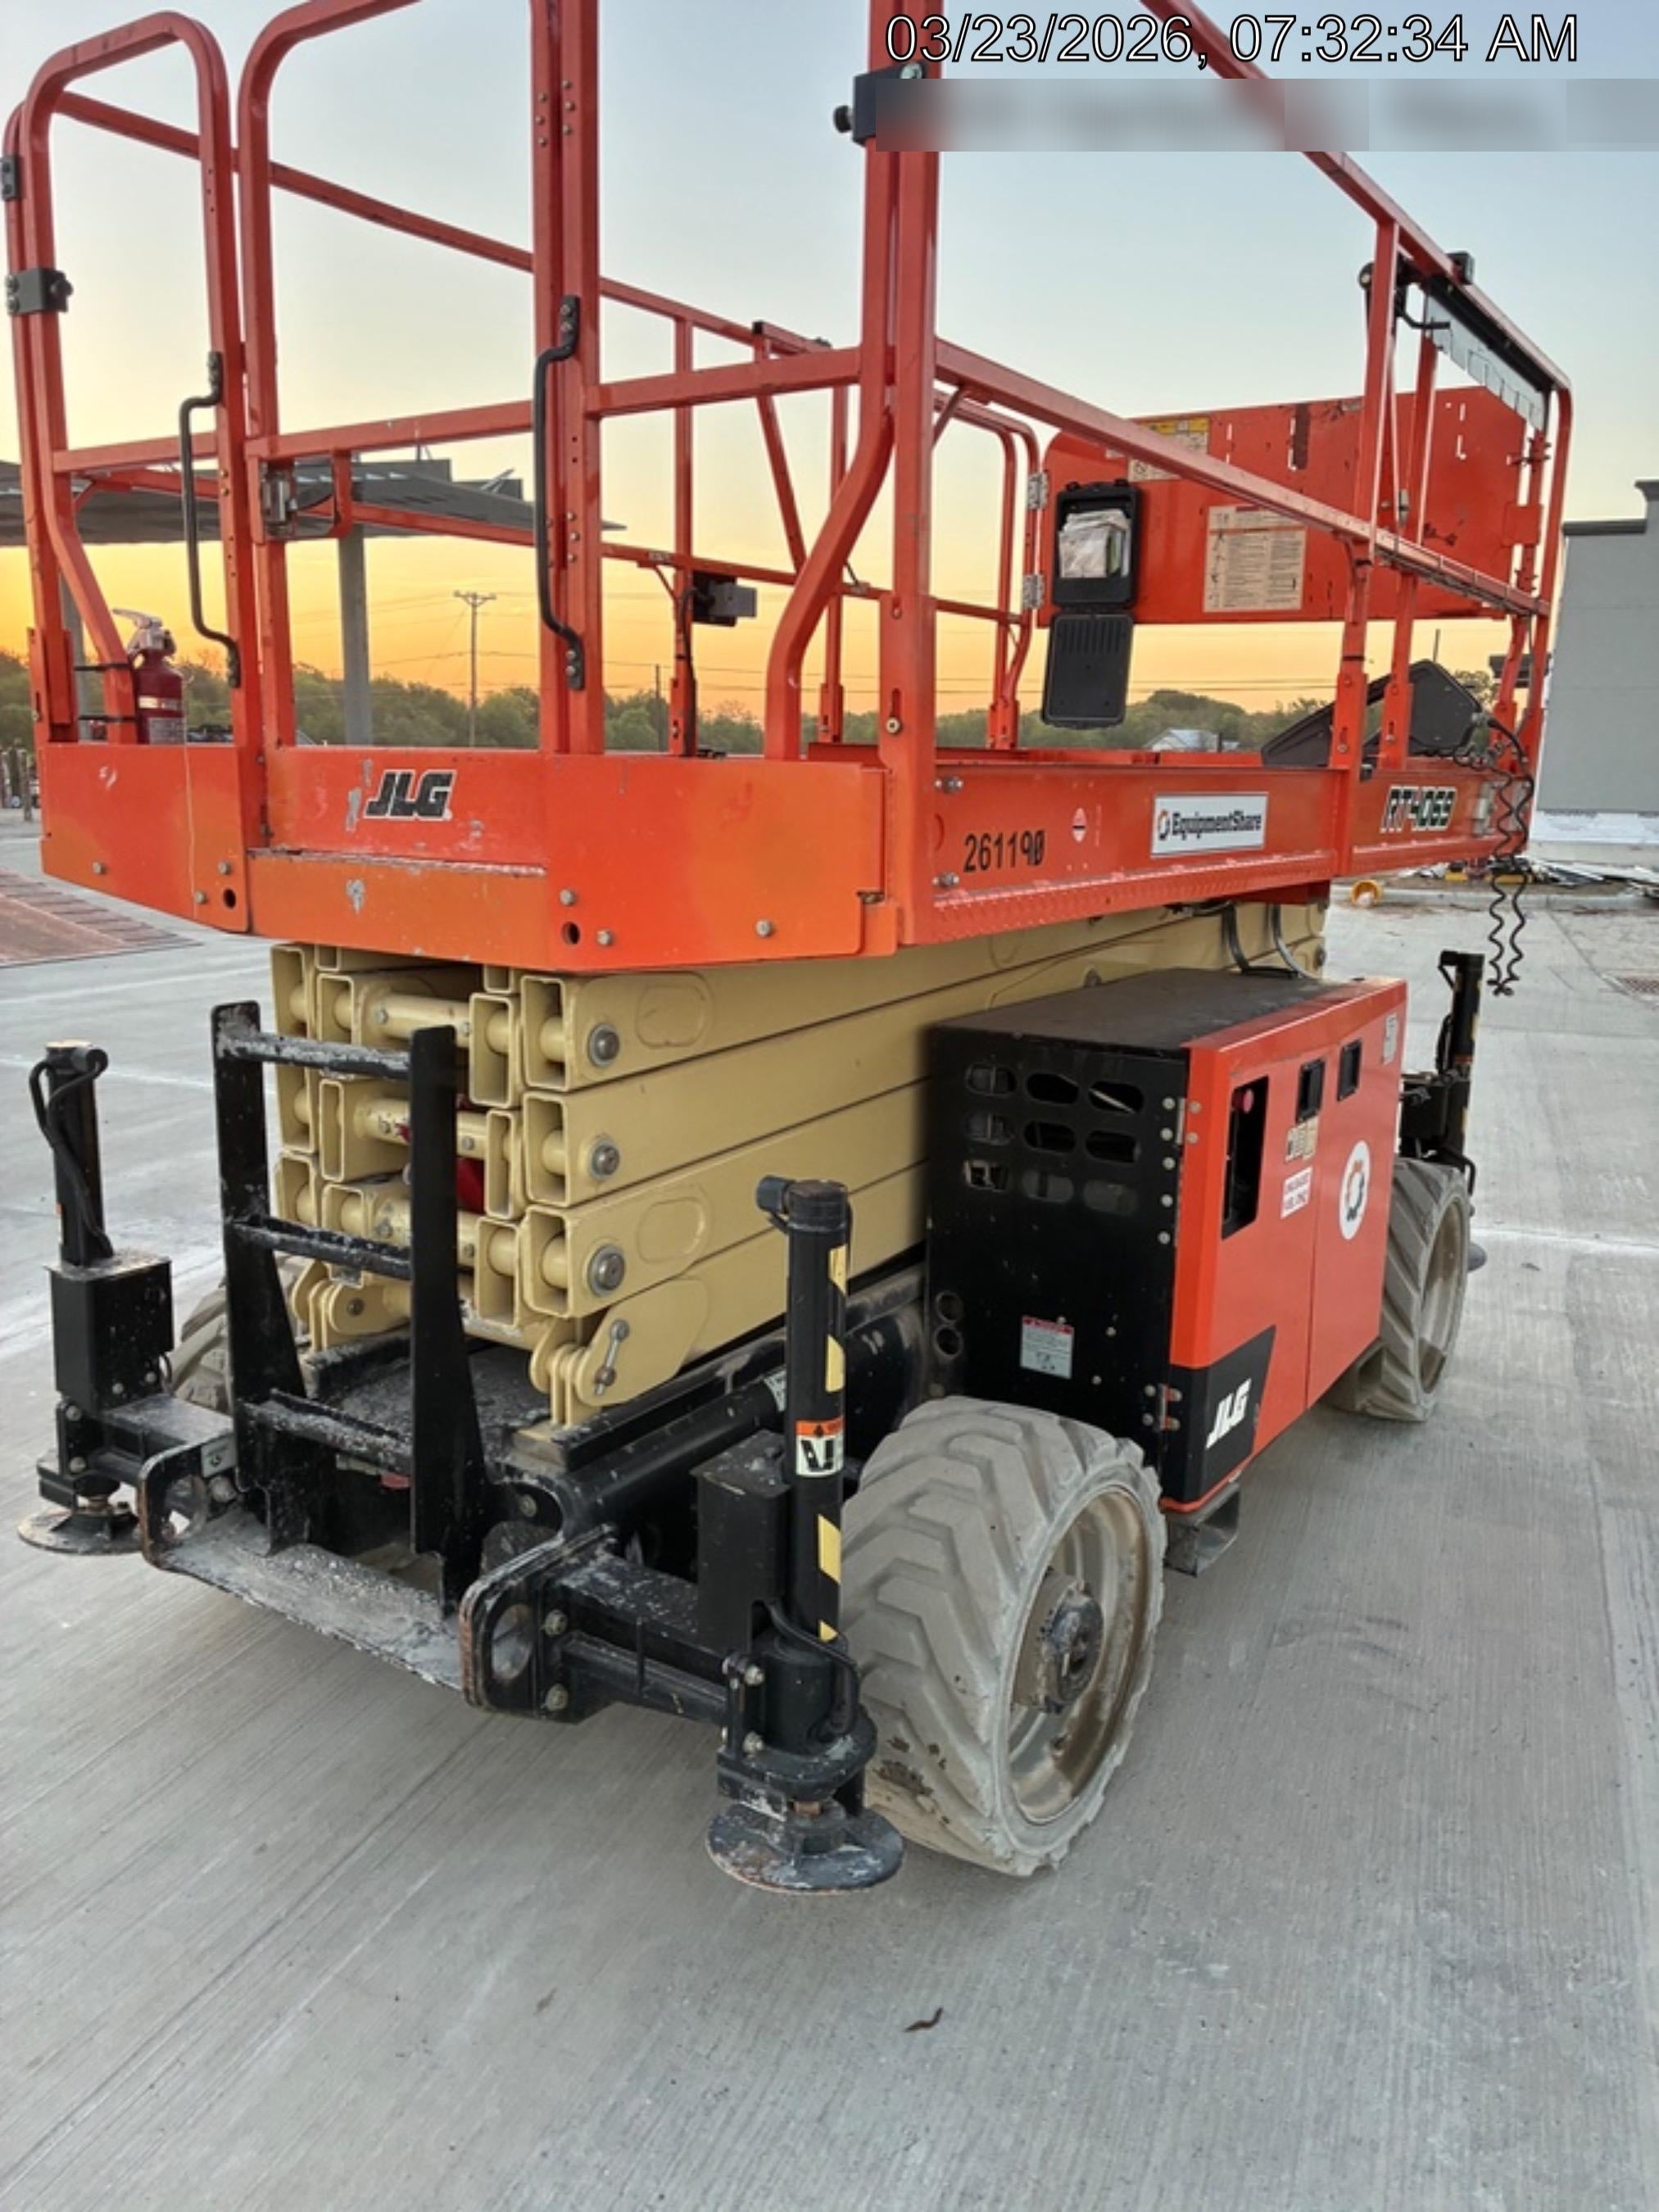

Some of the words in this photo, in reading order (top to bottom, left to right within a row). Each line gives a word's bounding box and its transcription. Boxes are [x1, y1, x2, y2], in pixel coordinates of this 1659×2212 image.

[363, 768, 456, 822] JLG
[1380, 784, 1457, 833] RT4069
[1171, 809, 1262, 841] EquipmentShare
[1205, 1376, 1252, 1450] JLG
